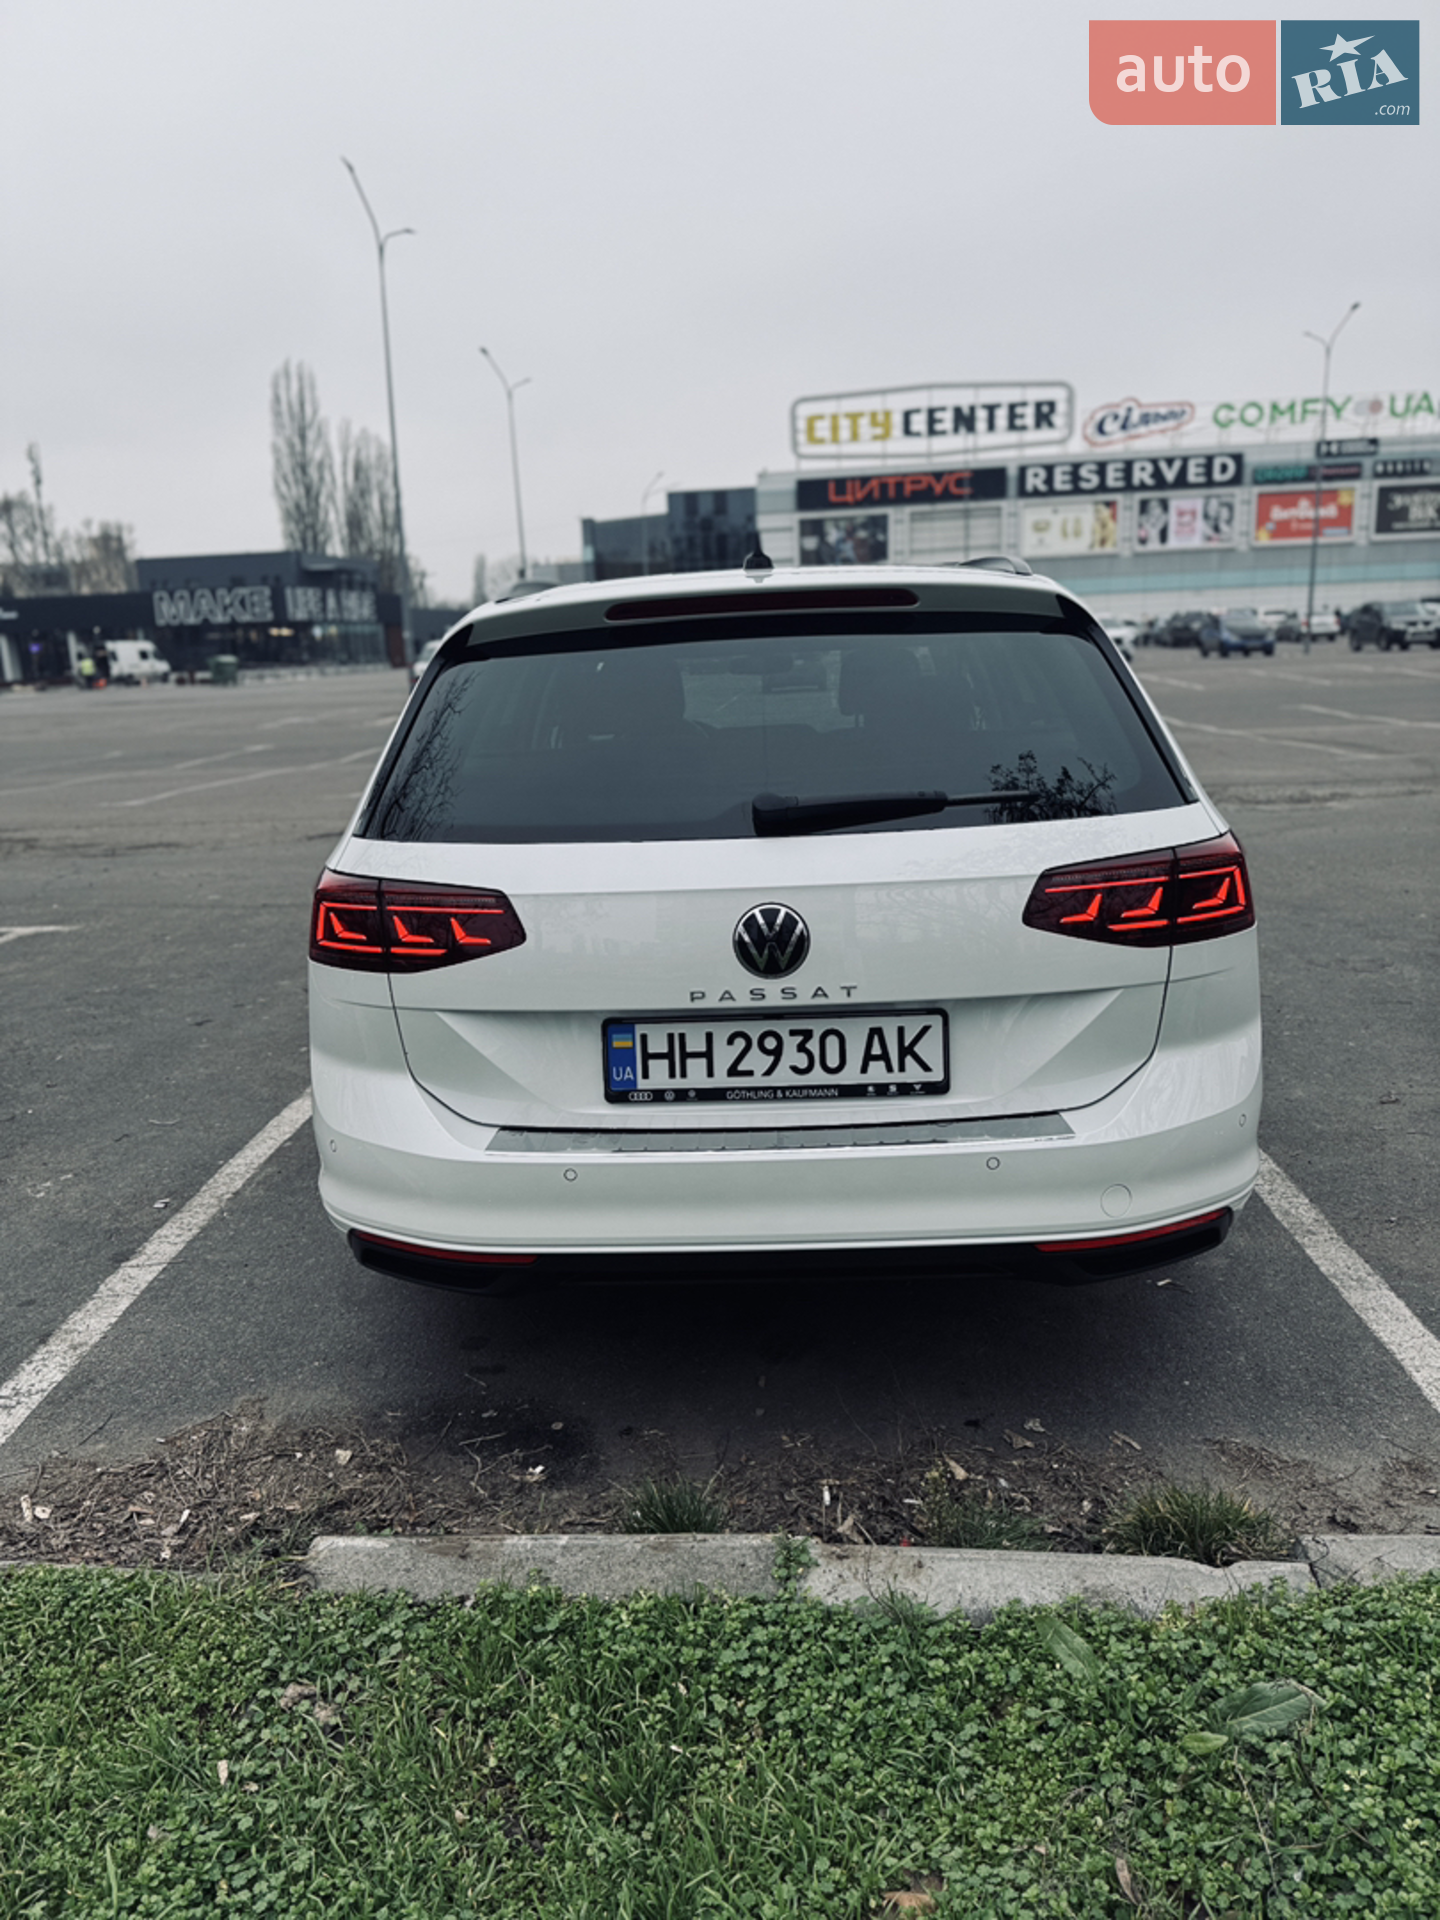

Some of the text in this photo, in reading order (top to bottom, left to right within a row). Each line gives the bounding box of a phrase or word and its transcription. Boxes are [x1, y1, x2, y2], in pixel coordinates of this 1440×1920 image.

[806, 400, 1057, 444] CITY CENTER
[1213, 395, 1352, 428] COMFY
[827, 470, 974, 505] ЦИТРУС
[1025, 455, 1237, 494] RESERVED
[689, 985, 858, 1003] PASSAT
[640, 1024, 933, 1080] HH 2930 AK
[612, 1066, 634, 1081] UA
[776, 1088, 783, 1098] &
[785, 1086, 839, 1098] KAUFMANN
